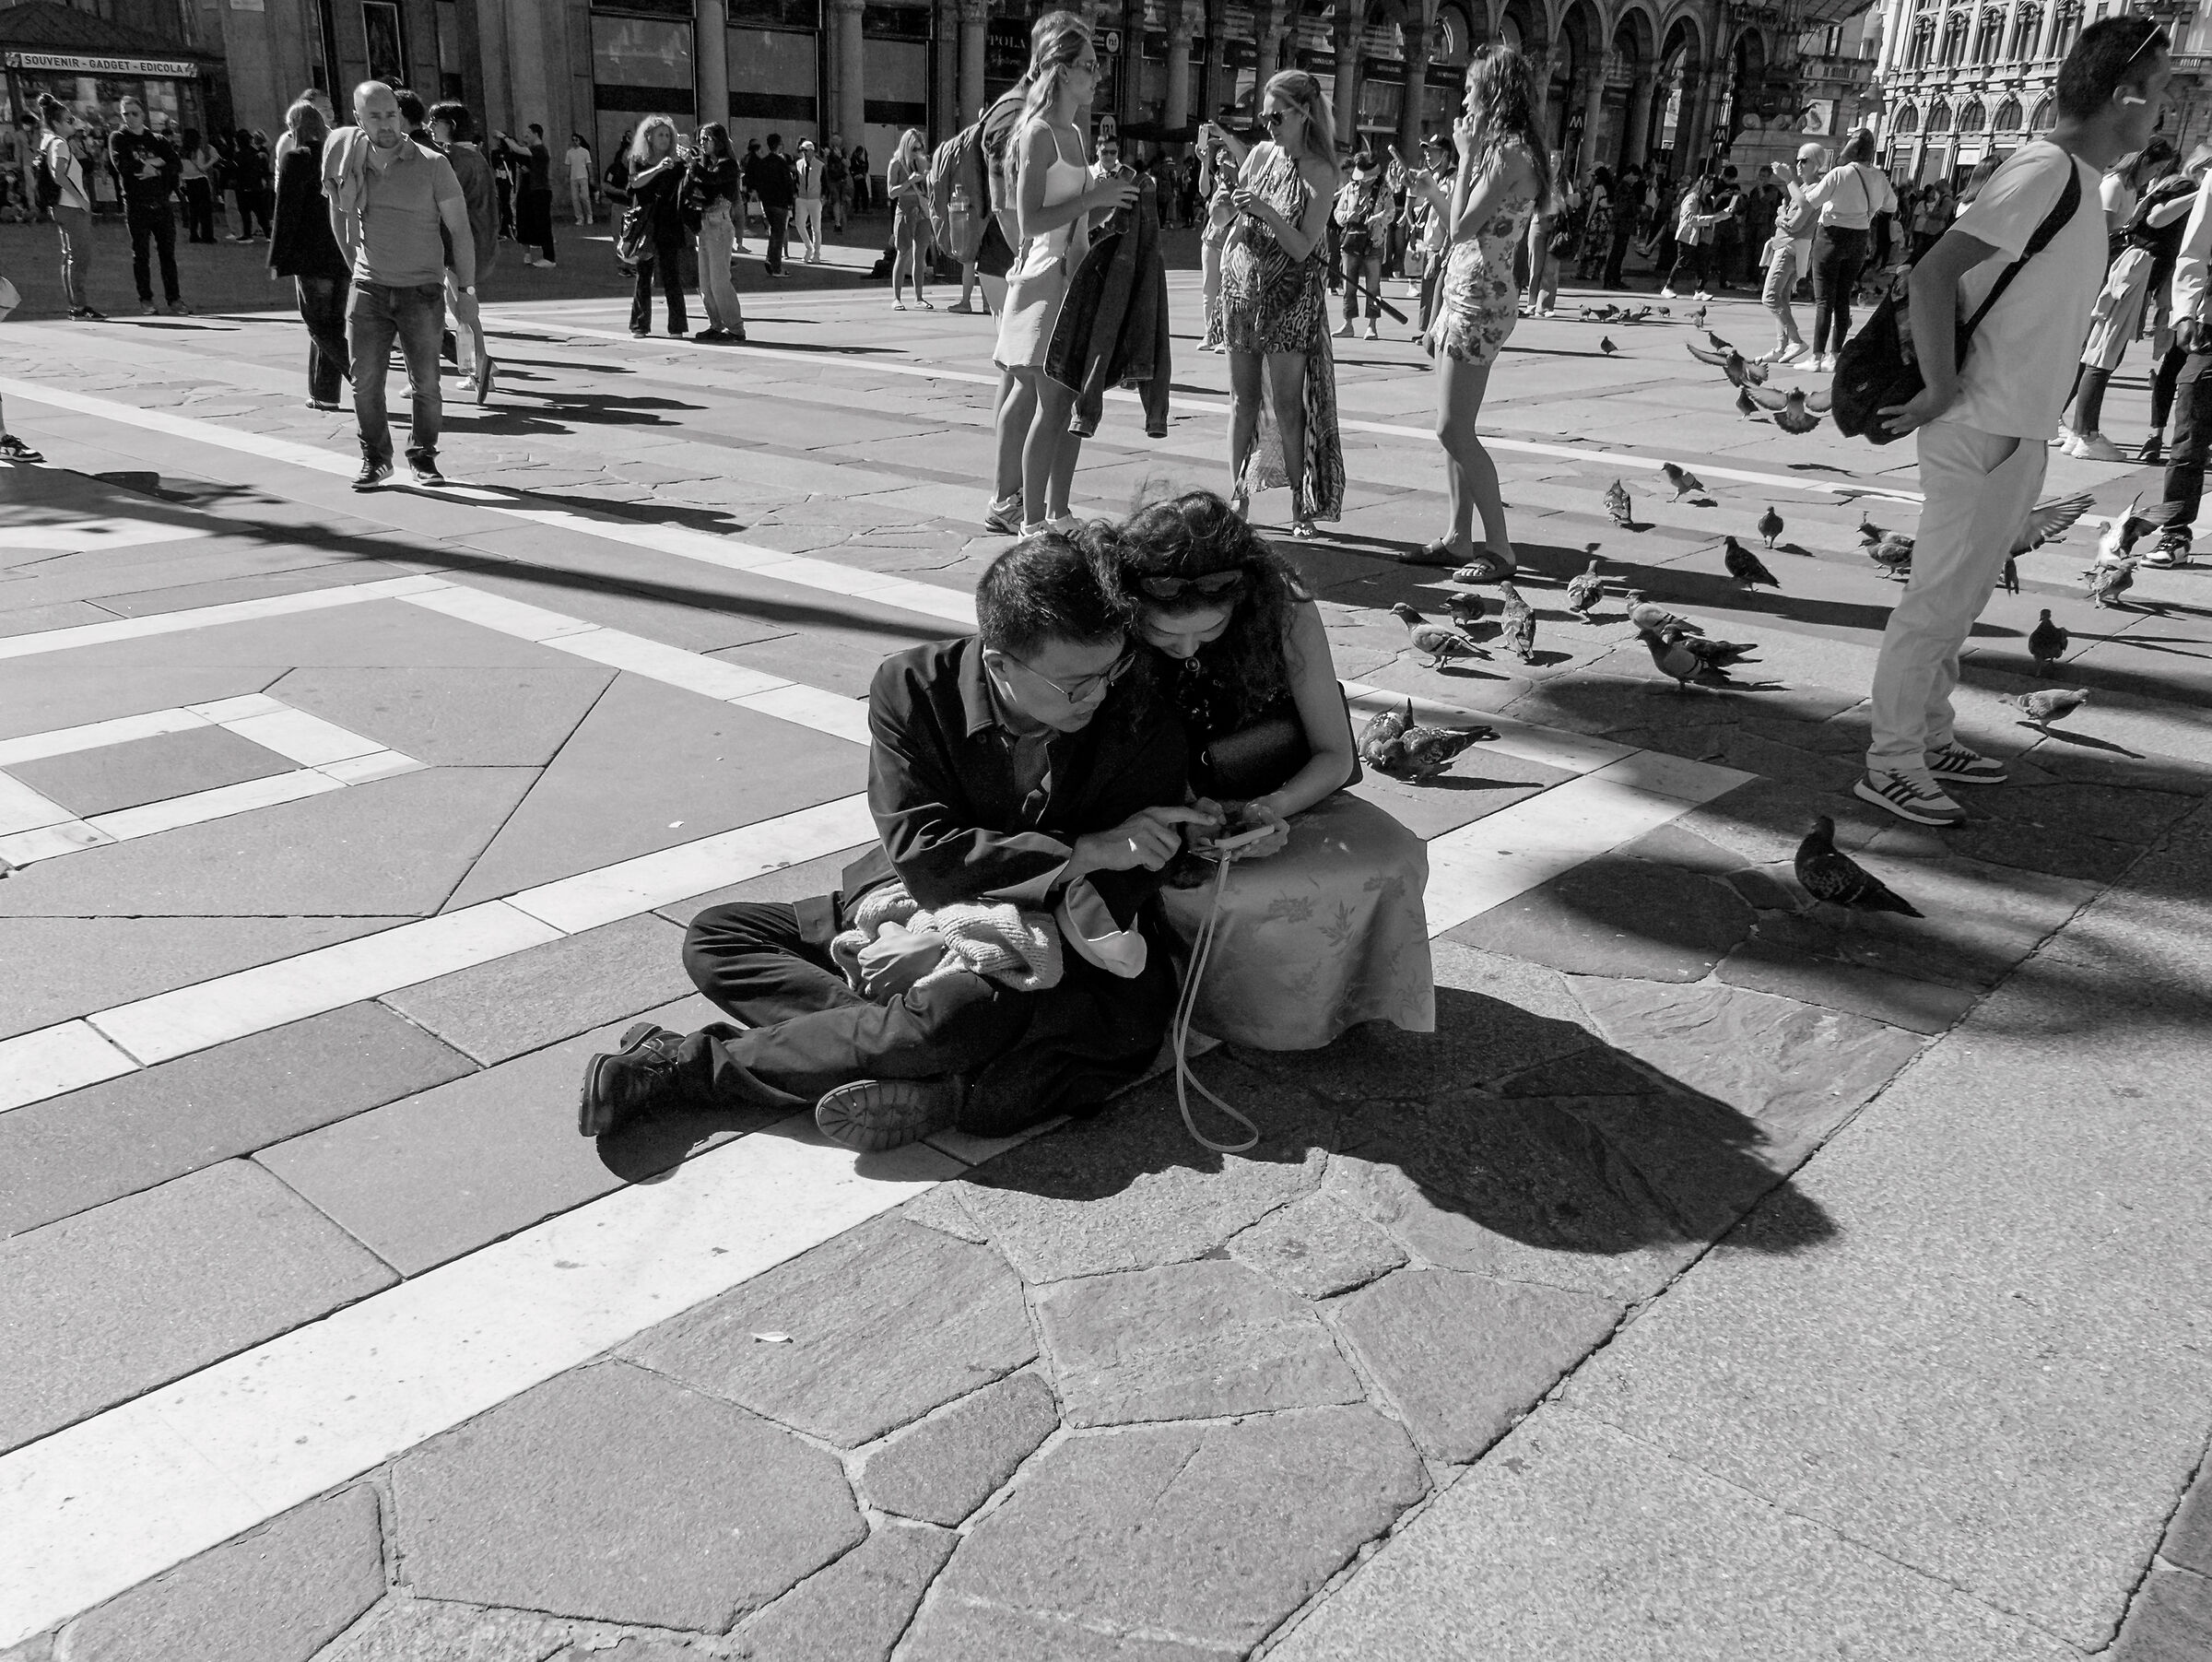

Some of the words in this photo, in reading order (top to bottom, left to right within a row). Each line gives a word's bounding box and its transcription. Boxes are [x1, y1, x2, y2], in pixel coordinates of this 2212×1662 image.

[25, 55, 80, 68] SOUVENIR
[89, 59, 131, 71] GADGET
[140, 63, 184, 74] EDICOLA
[1570, 115, 1583, 128] M
[1713, 128, 1726, 140] M
